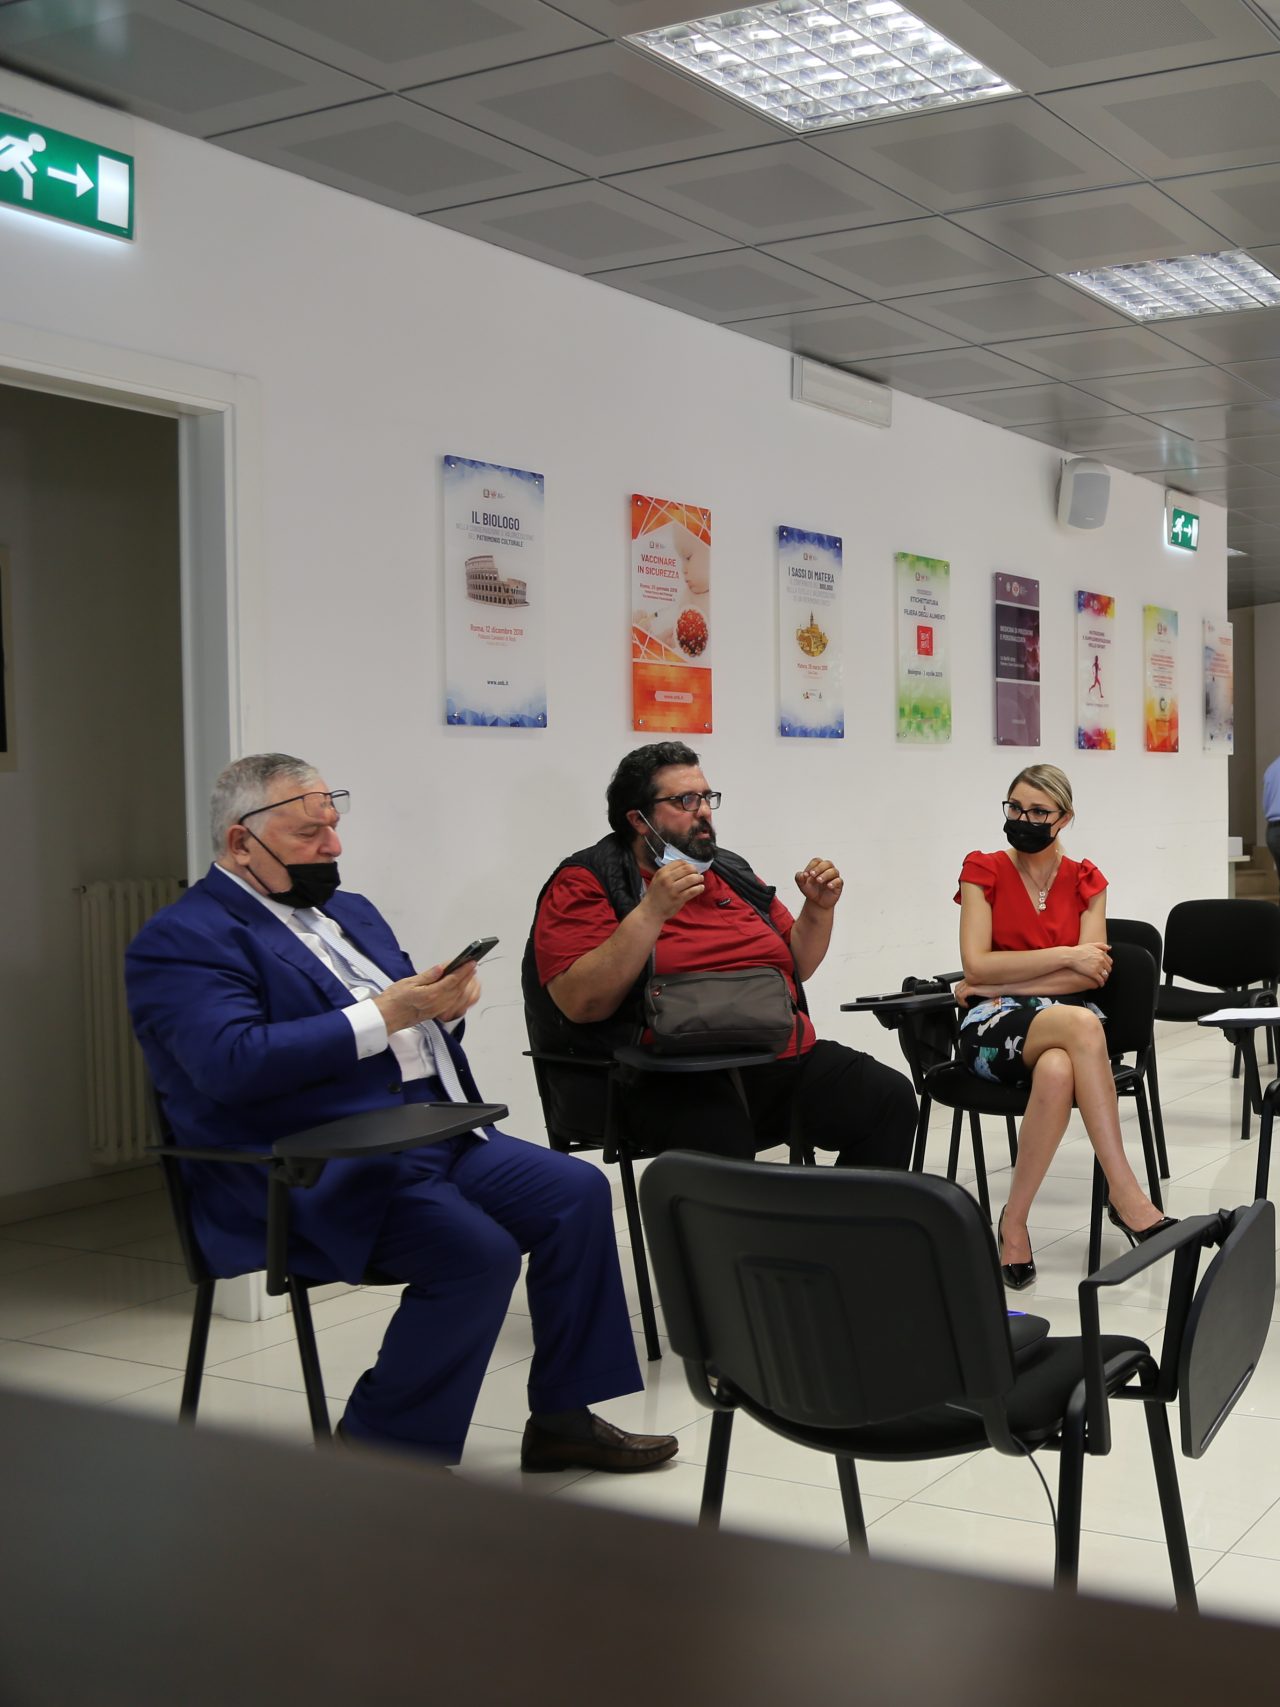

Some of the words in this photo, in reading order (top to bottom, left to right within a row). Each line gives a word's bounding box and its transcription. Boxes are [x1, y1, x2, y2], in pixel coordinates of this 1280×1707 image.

[471, 510, 480, 524] IL
[482, 512, 520, 531] BIOLOGO
[476, 534, 500, 544] PATRIMONIO
[501, 538, 523, 548] CULTURALE
[641, 553, 676, 567] VACCINARE
[637, 565, 644, 574] IN
[645, 566, 679, 579] SICUREZZA
[791, 567, 806, 579] SASSI
[807, 570, 813, 580] DI
[814, 571, 834, 583] MATERA
